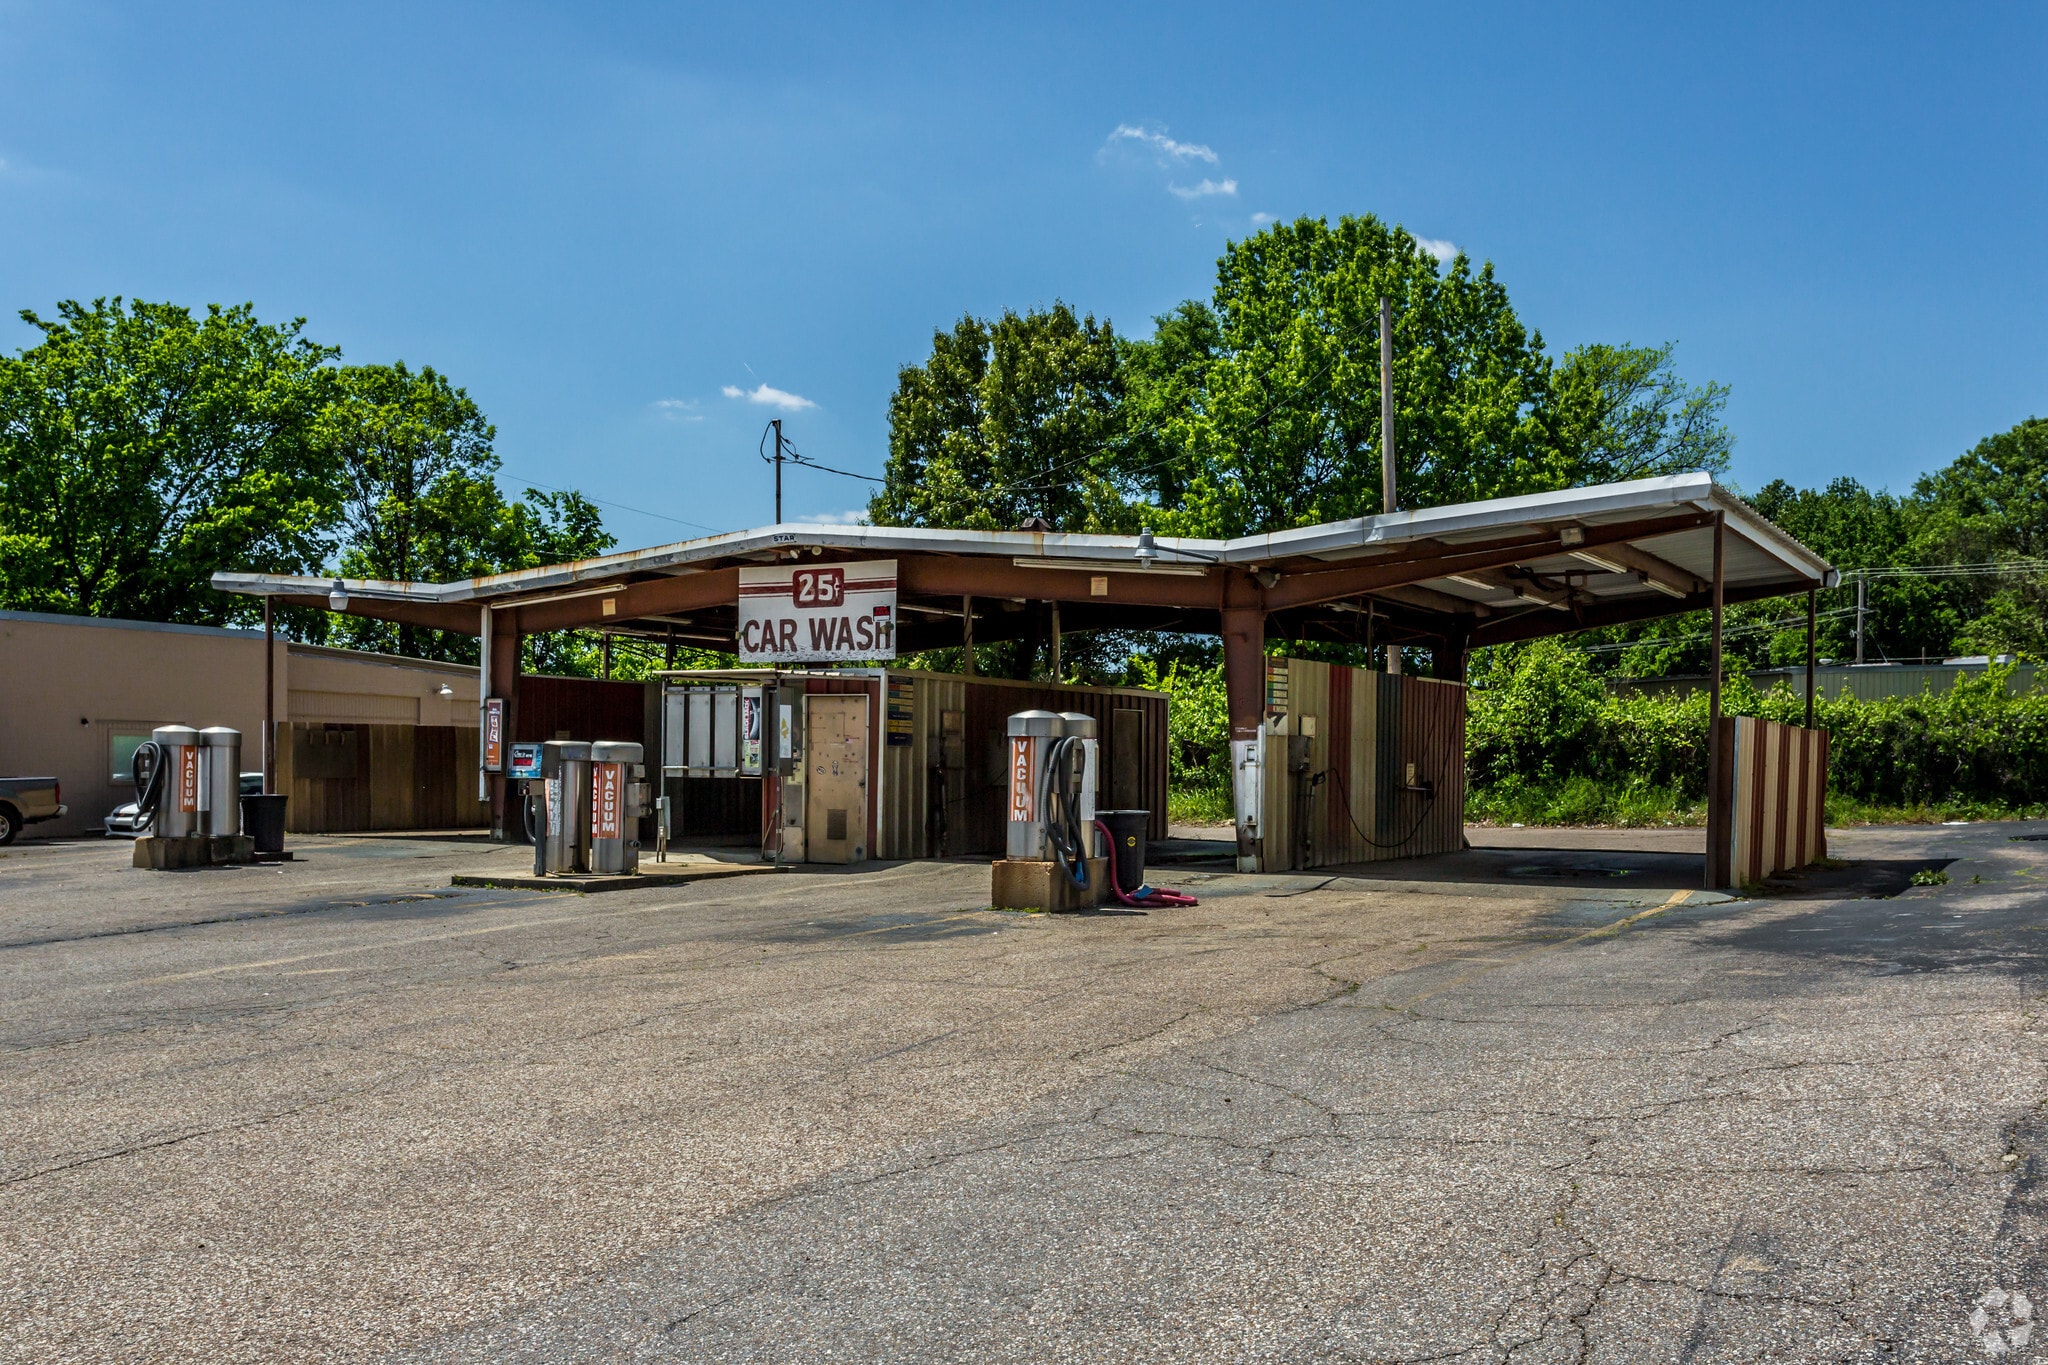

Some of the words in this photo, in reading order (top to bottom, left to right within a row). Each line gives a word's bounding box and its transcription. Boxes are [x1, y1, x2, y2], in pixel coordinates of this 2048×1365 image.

[798, 573, 840, 602] 25¢
[743, 618, 798, 653] CAR
[809, 615, 891, 651] WASH
[183, 751, 194, 806] VACUUM
[602, 770, 615, 832] VACUUM
[1014, 741, 1028, 822] VACUUM
